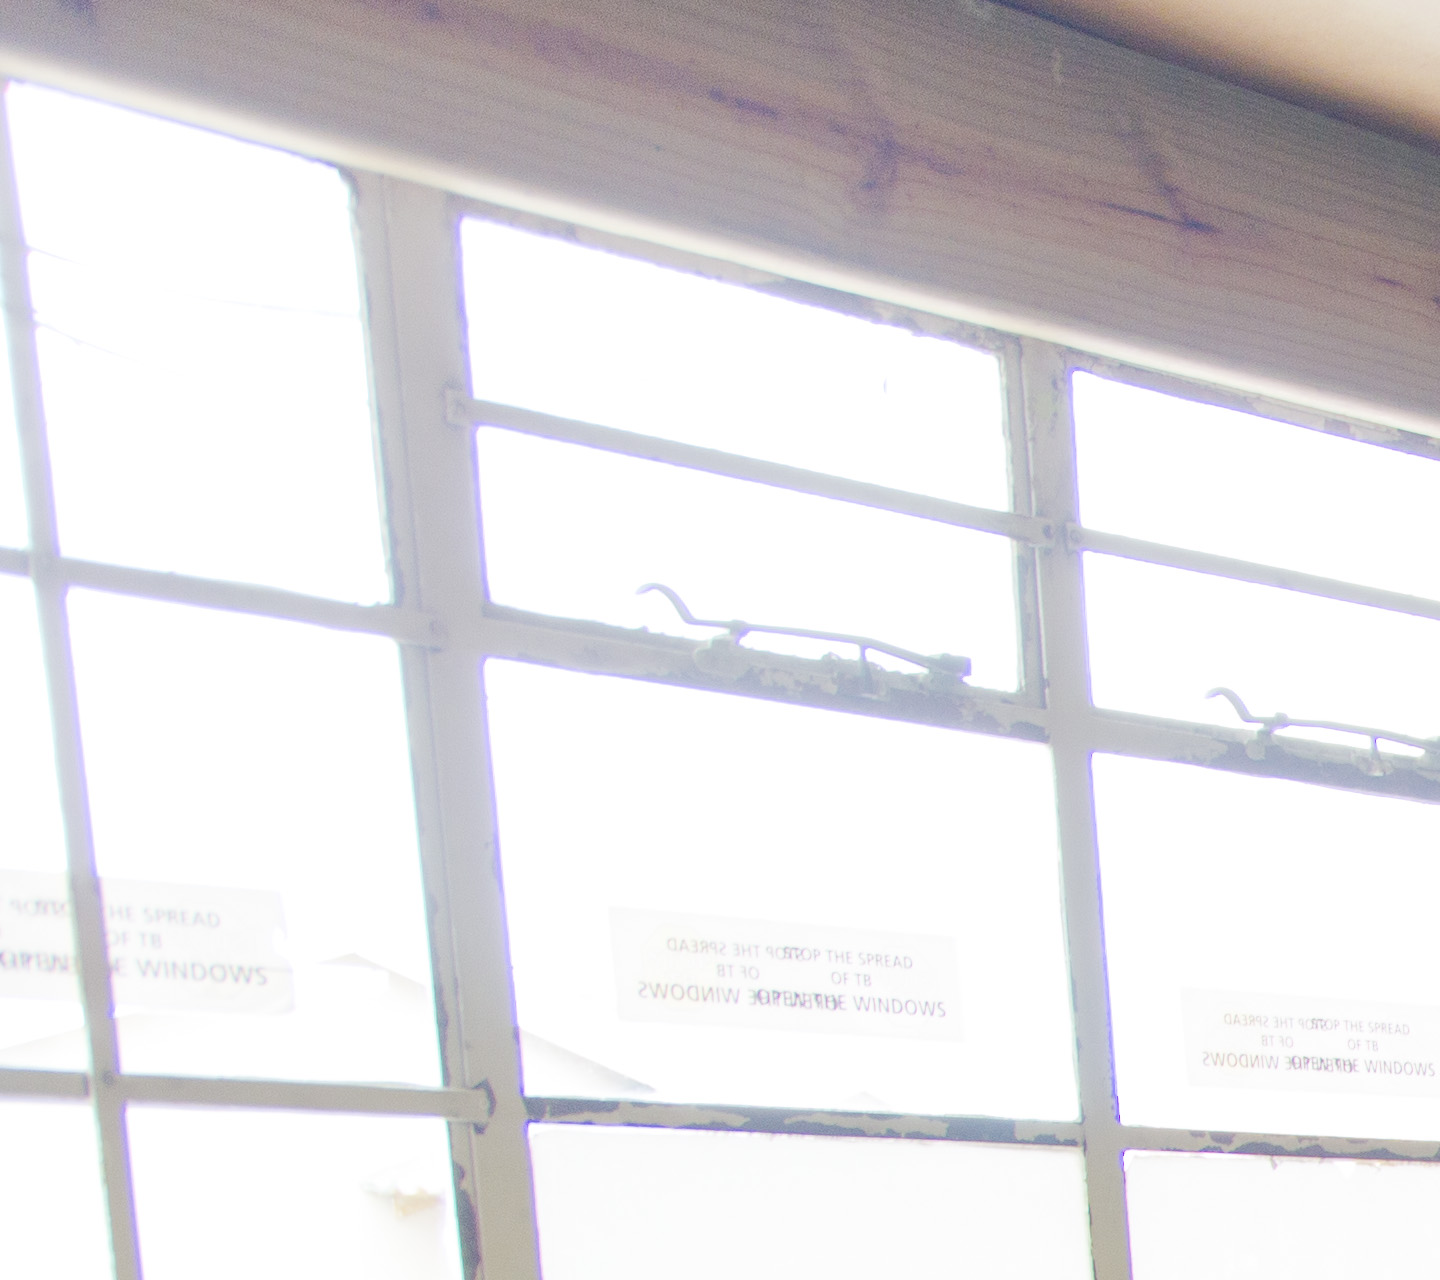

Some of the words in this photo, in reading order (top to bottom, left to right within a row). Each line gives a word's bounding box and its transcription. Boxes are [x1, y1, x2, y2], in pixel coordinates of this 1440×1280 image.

[108, 906, 136, 923] HE
[143, 906, 221, 929] SPREAD
[108, 930, 131, 947] OF
[139, 931, 163, 950] TB
[826, 950, 852, 965] THE
[858, 952, 914, 970] SPREAD
[136, 957, 269, 986] WINDOWS
[831, 970, 849, 985] OF
[855, 973, 872, 988] TB
[853, 994, 947, 1018] WINDOWS
[1344, 1019, 1364, 1033] THE
[1368, 1021, 1410, 1036] SPREAD
[1347, 1038, 1361, 1051] OF
[1366, 1039, 1379, 1052] TB
[1364, 1058, 1436, 1078] WINDOWS
